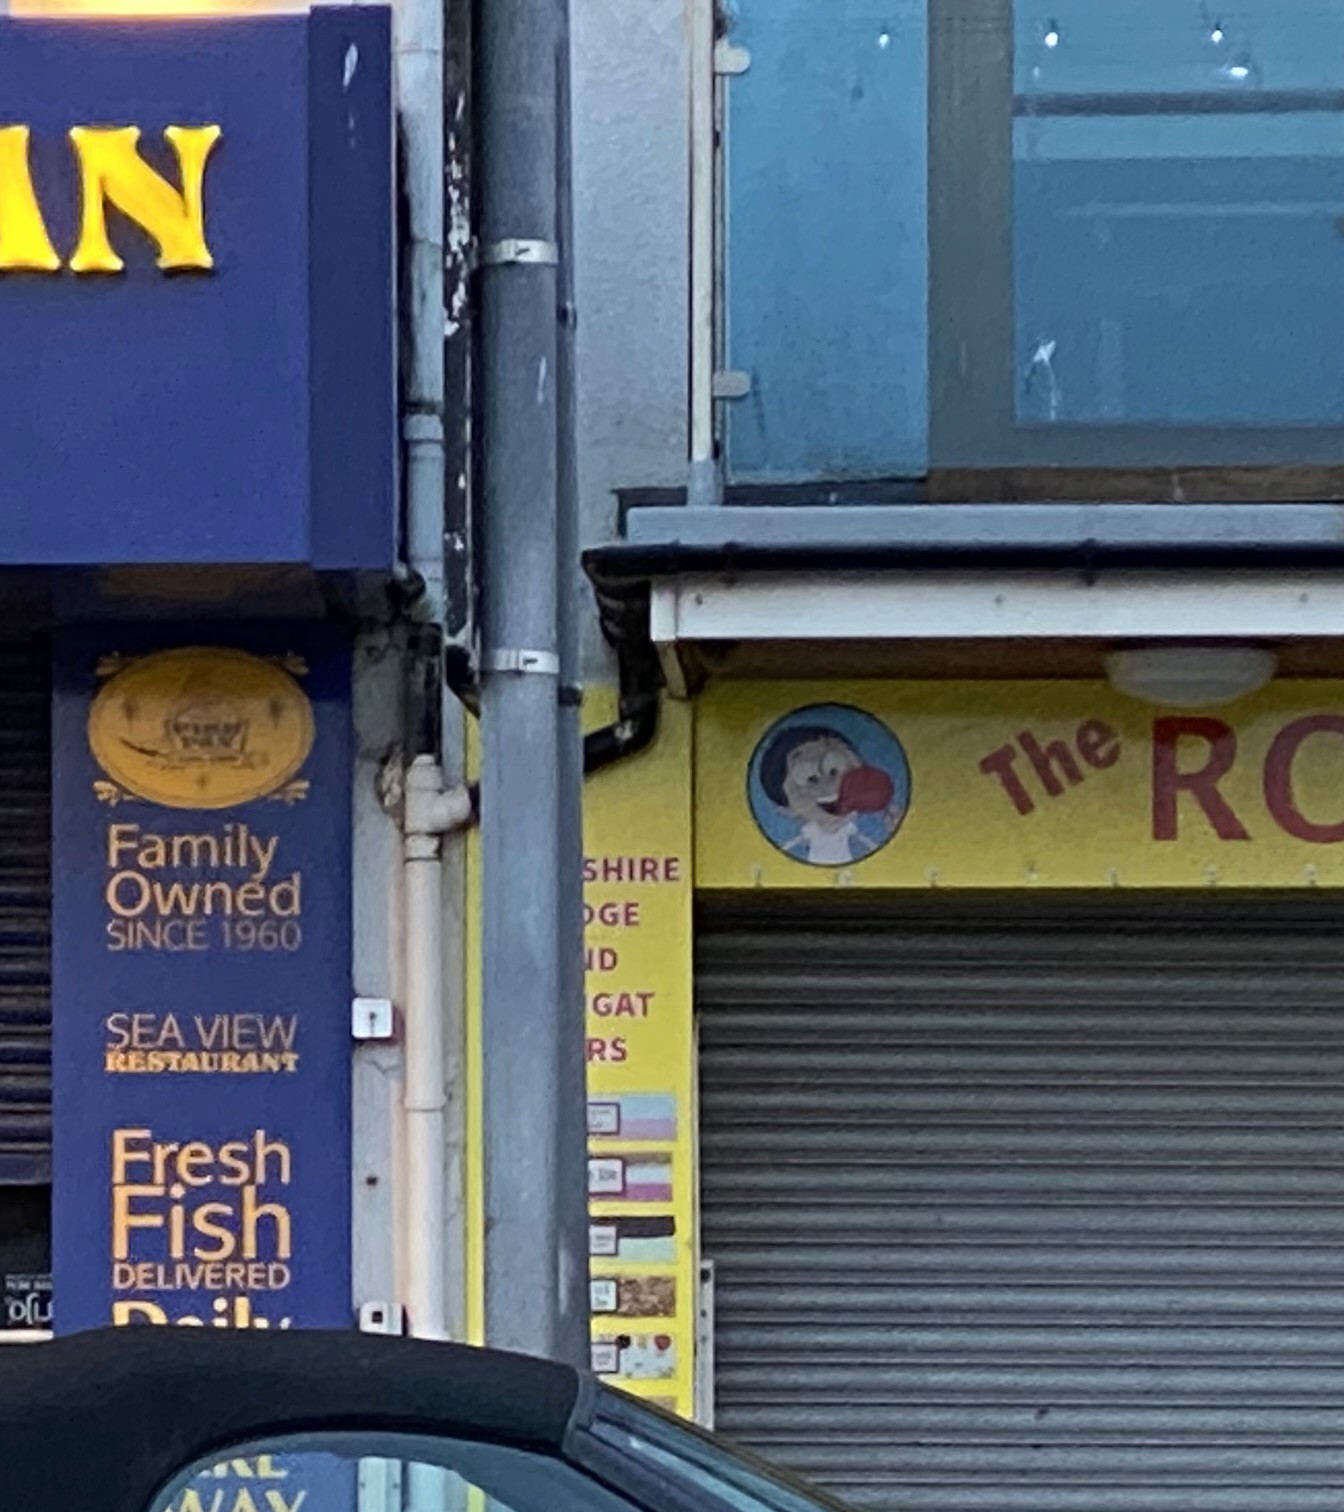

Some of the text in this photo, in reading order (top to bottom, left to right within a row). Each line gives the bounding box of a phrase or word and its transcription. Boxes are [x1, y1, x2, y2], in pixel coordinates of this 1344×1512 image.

[979, 718, 1122, 817] The
[108, 822, 279, 884] Family
[582, 857, 680, 882] SHIRE
[106, 870, 302, 917] Owned
[107, 921, 302, 951] SINCE 1960
[592, 992, 655, 1018] GAT
[107, 1013, 298, 1050] SEA VIEW
[105, 1050, 299, 1074] RESTAURANT
[112, 1129, 291, 1187] Fresh
[112, 1184, 292, 1262] Fish
[113, 1262, 292, 1292] DELIVERED
